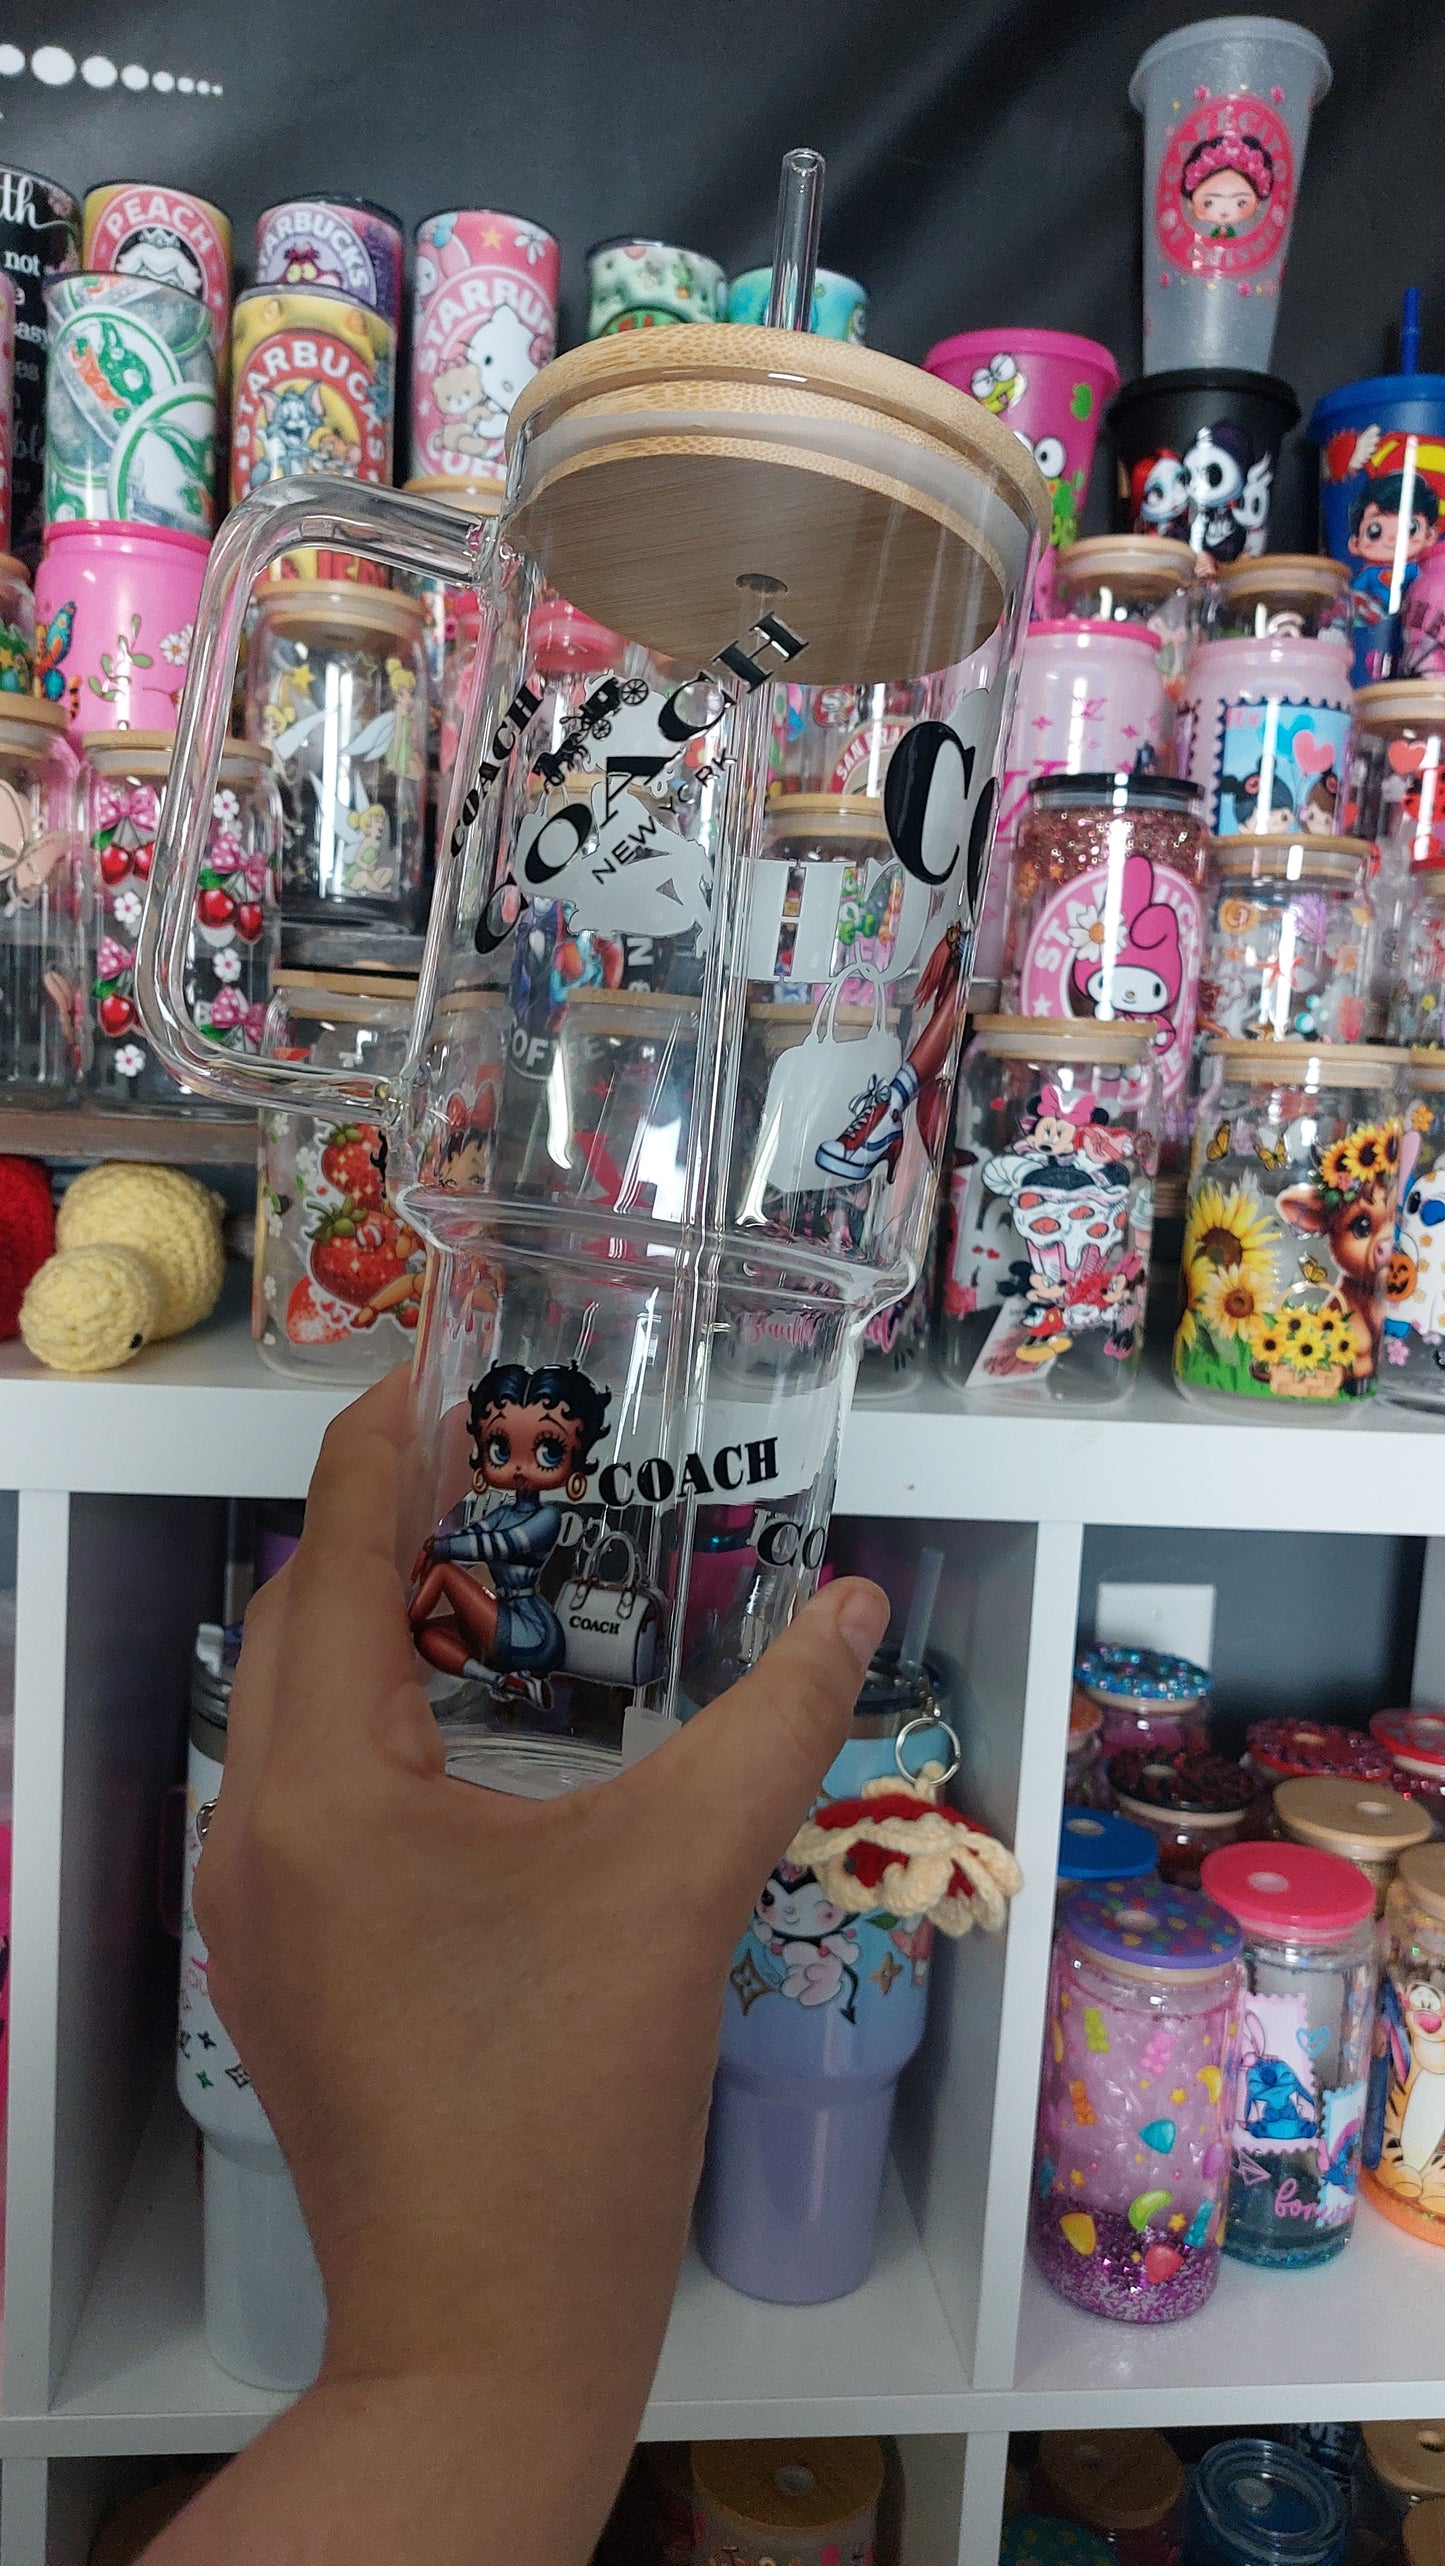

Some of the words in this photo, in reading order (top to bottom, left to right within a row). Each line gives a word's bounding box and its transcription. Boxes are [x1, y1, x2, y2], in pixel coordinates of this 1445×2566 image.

[105, 195, 215, 251] PEACH
[3, 251, 42, 277] not
[451, 681, 546, 857] COACH
[474, 611, 810, 955] COACH
[836, 738, 865, 781] SAN
[591, 814, 657, 884] NEW
[599, 1436, 779, 1506] COACH
[569, 1614, 621, 1635] COACH
